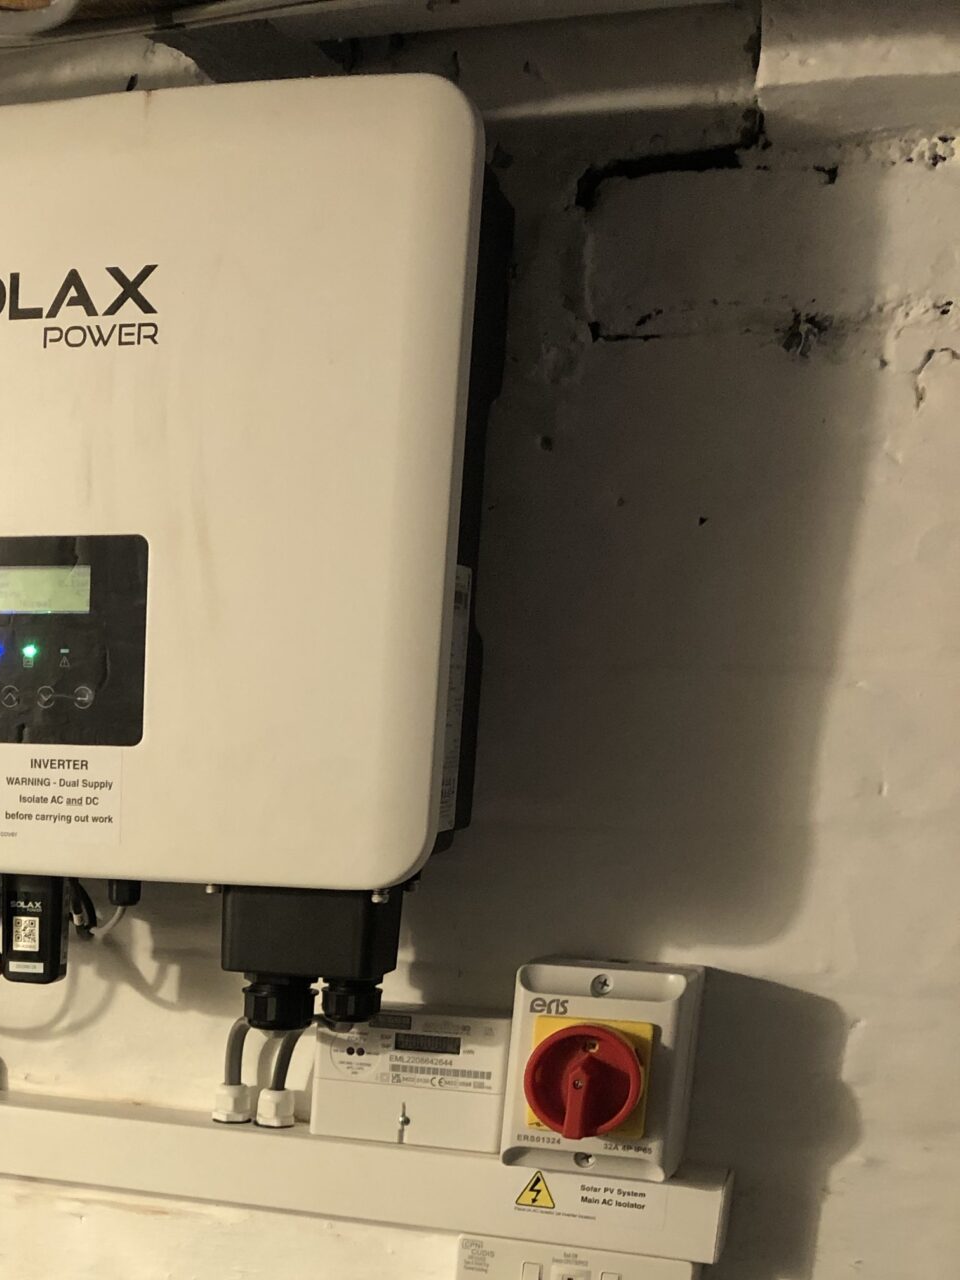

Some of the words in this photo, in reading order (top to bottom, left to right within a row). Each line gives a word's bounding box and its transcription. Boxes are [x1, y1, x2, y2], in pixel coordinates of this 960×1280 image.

[43, 322, 158, 348] POWER
[30, 758, 89, 770] INVERTER
[6, 776, 51, 787] WARNING
[58, 779, 79, 788] Dual
[81, 780, 113, 790] Supply
[19, 794, 49, 804] Isolate
[50, 795, 64, 805] AC
[66, 796, 83, 806] and
[85, 797, 99, 806] DC
[5, 810, 33, 821] before
[35, 811, 72, 824] carrying
[74, 814, 89, 823] out
[91, 814, 113, 823] work
[10, 900, 42, 908] SOLAX
[603, 1142, 619, 1151] 32A
[580, 1184, 601, 1193] Solar
[603, 1186, 615, 1194] PV
[616, 1188, 646, 1198] System
[580, 1195, 599, 1204] Main
[601, 1198, 613, 1206] AC
[615, 1200, 645, 1210] Isolator
